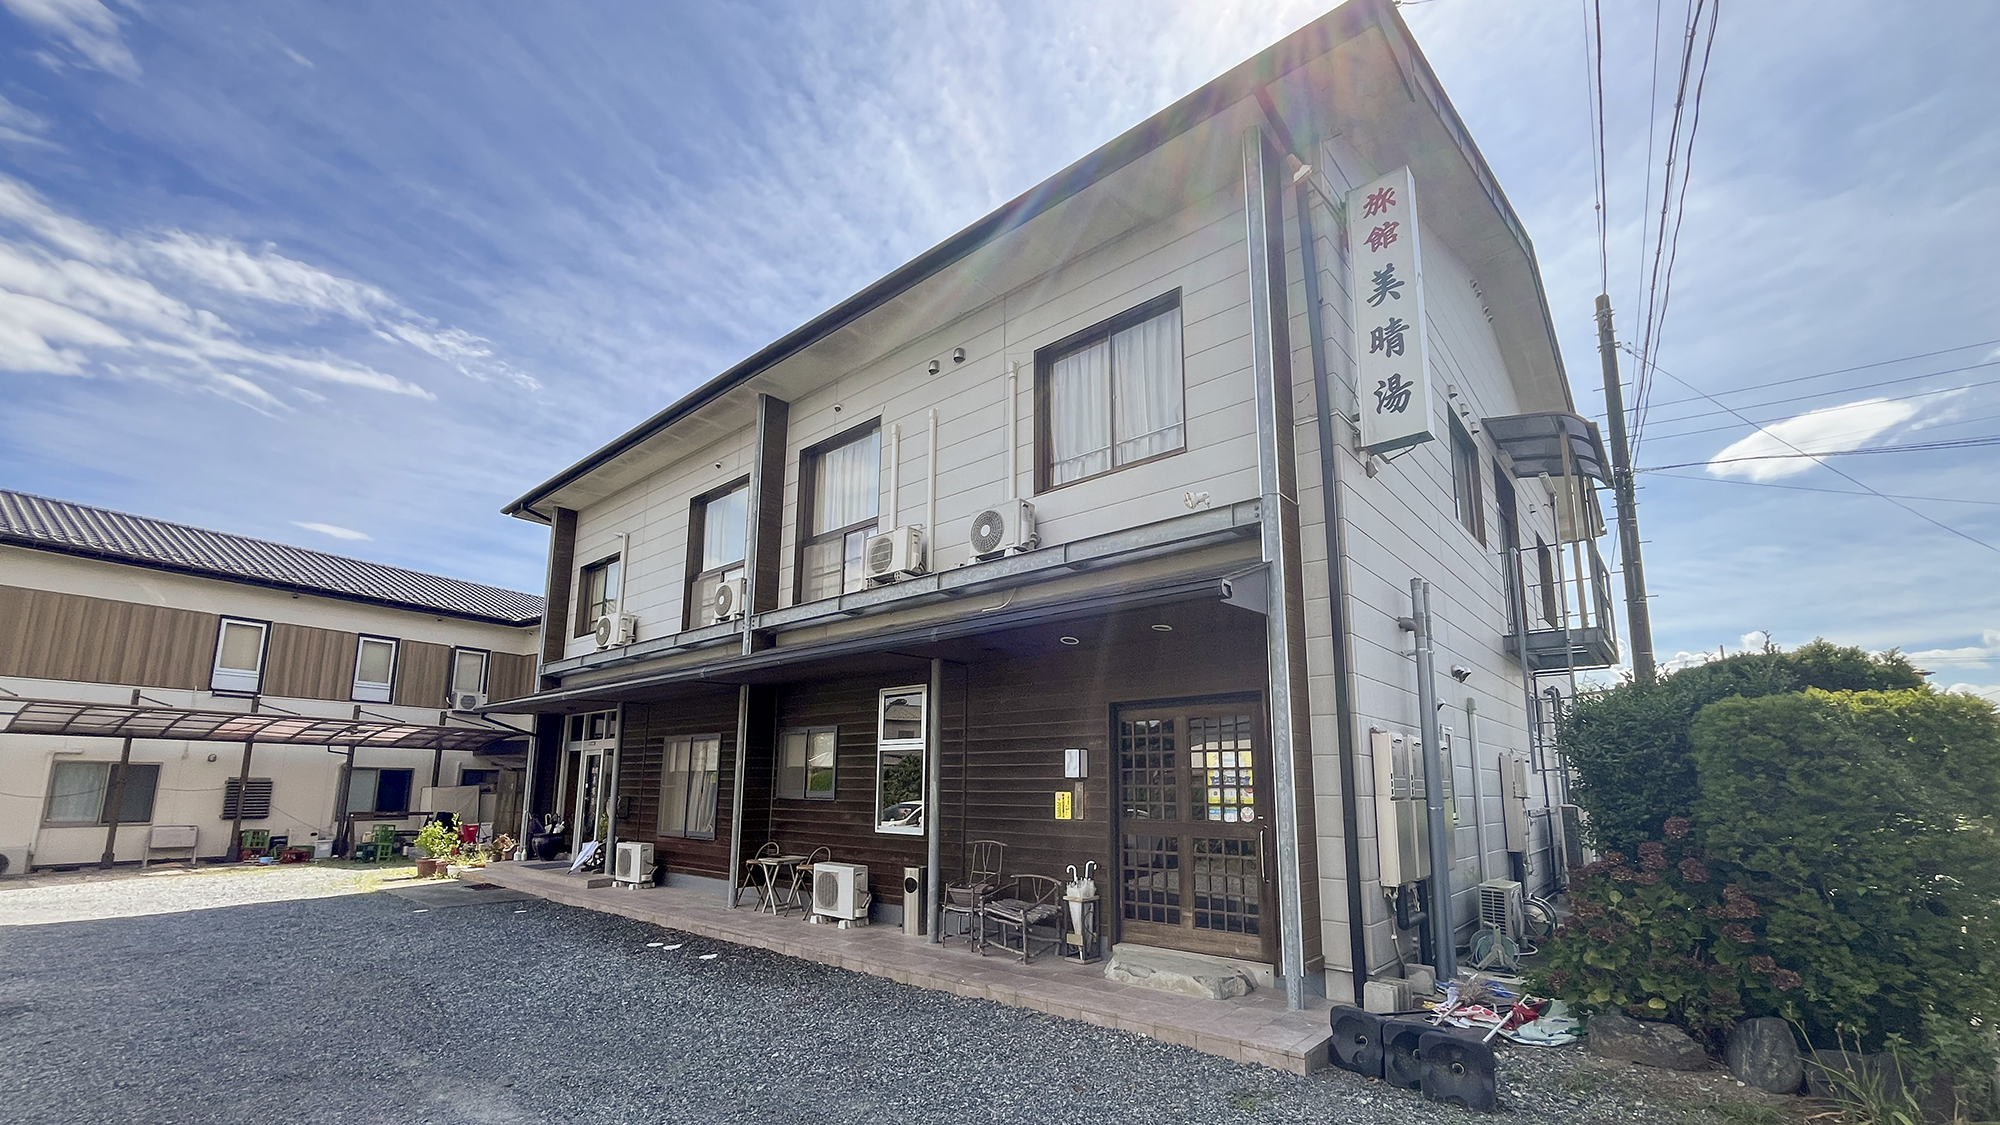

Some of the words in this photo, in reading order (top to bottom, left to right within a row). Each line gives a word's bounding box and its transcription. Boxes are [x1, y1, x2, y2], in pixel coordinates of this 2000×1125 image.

[1363, 187, 1400, 252] 旅館
[1366, 263, 1414, 414] 美晴湯
